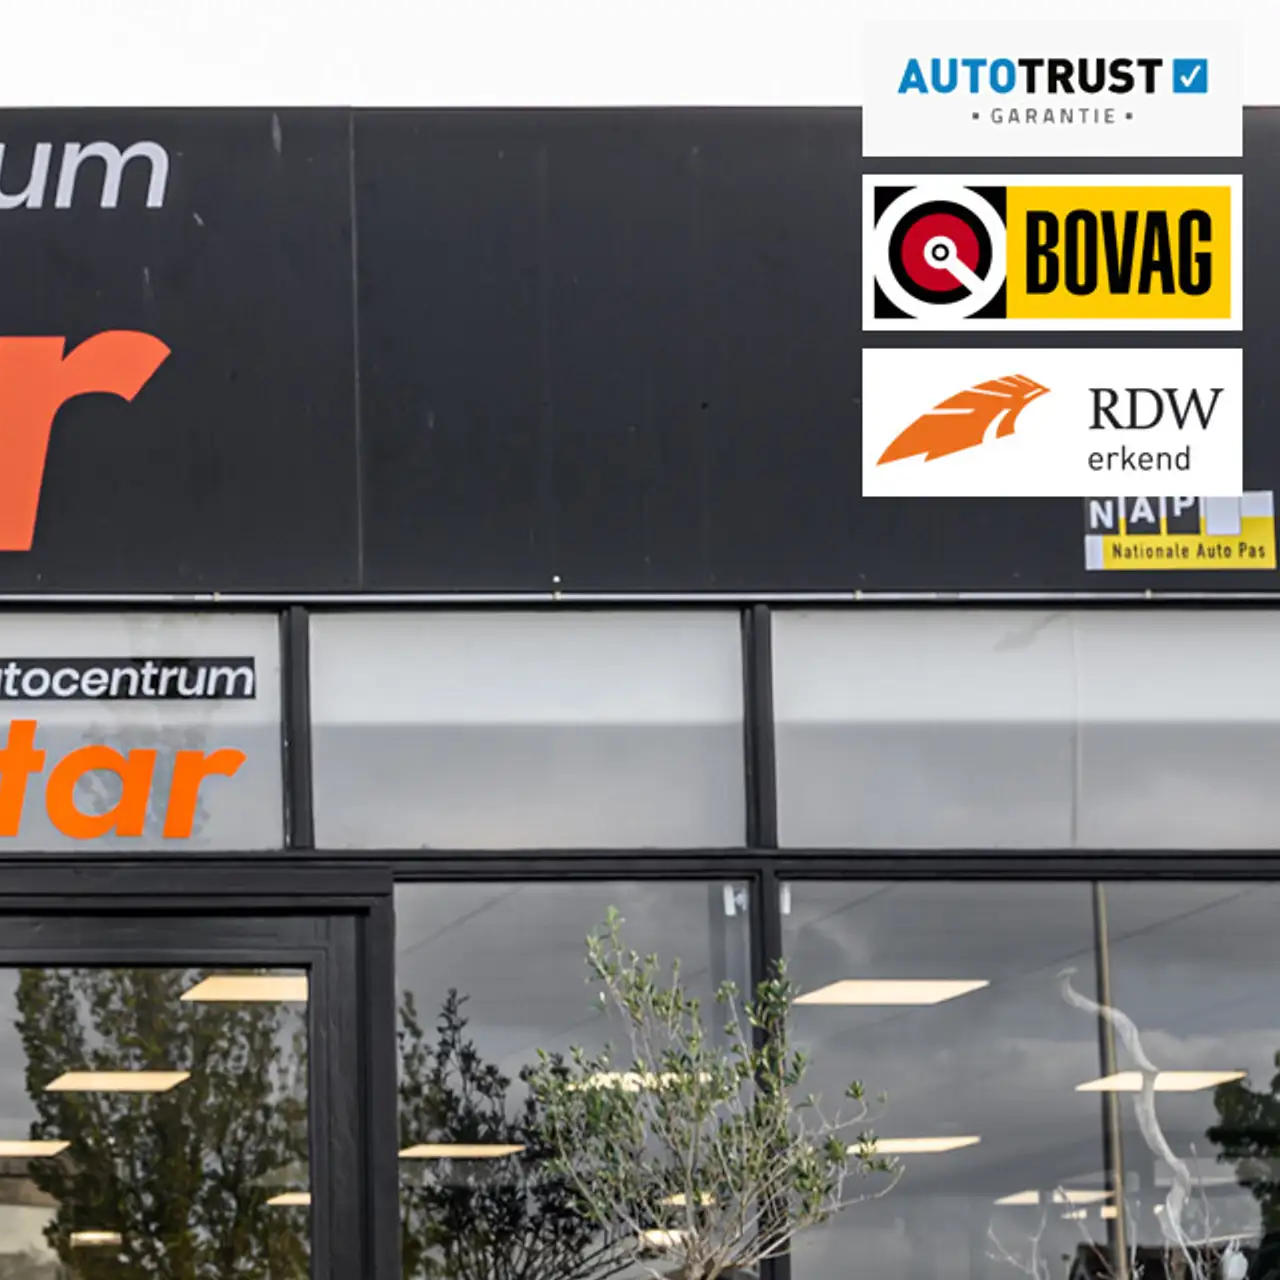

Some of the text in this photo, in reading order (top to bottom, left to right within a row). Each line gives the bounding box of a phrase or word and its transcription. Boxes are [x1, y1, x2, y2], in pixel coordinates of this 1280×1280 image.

[1111, 542, 1266, 559] Nationale Auto Pas
